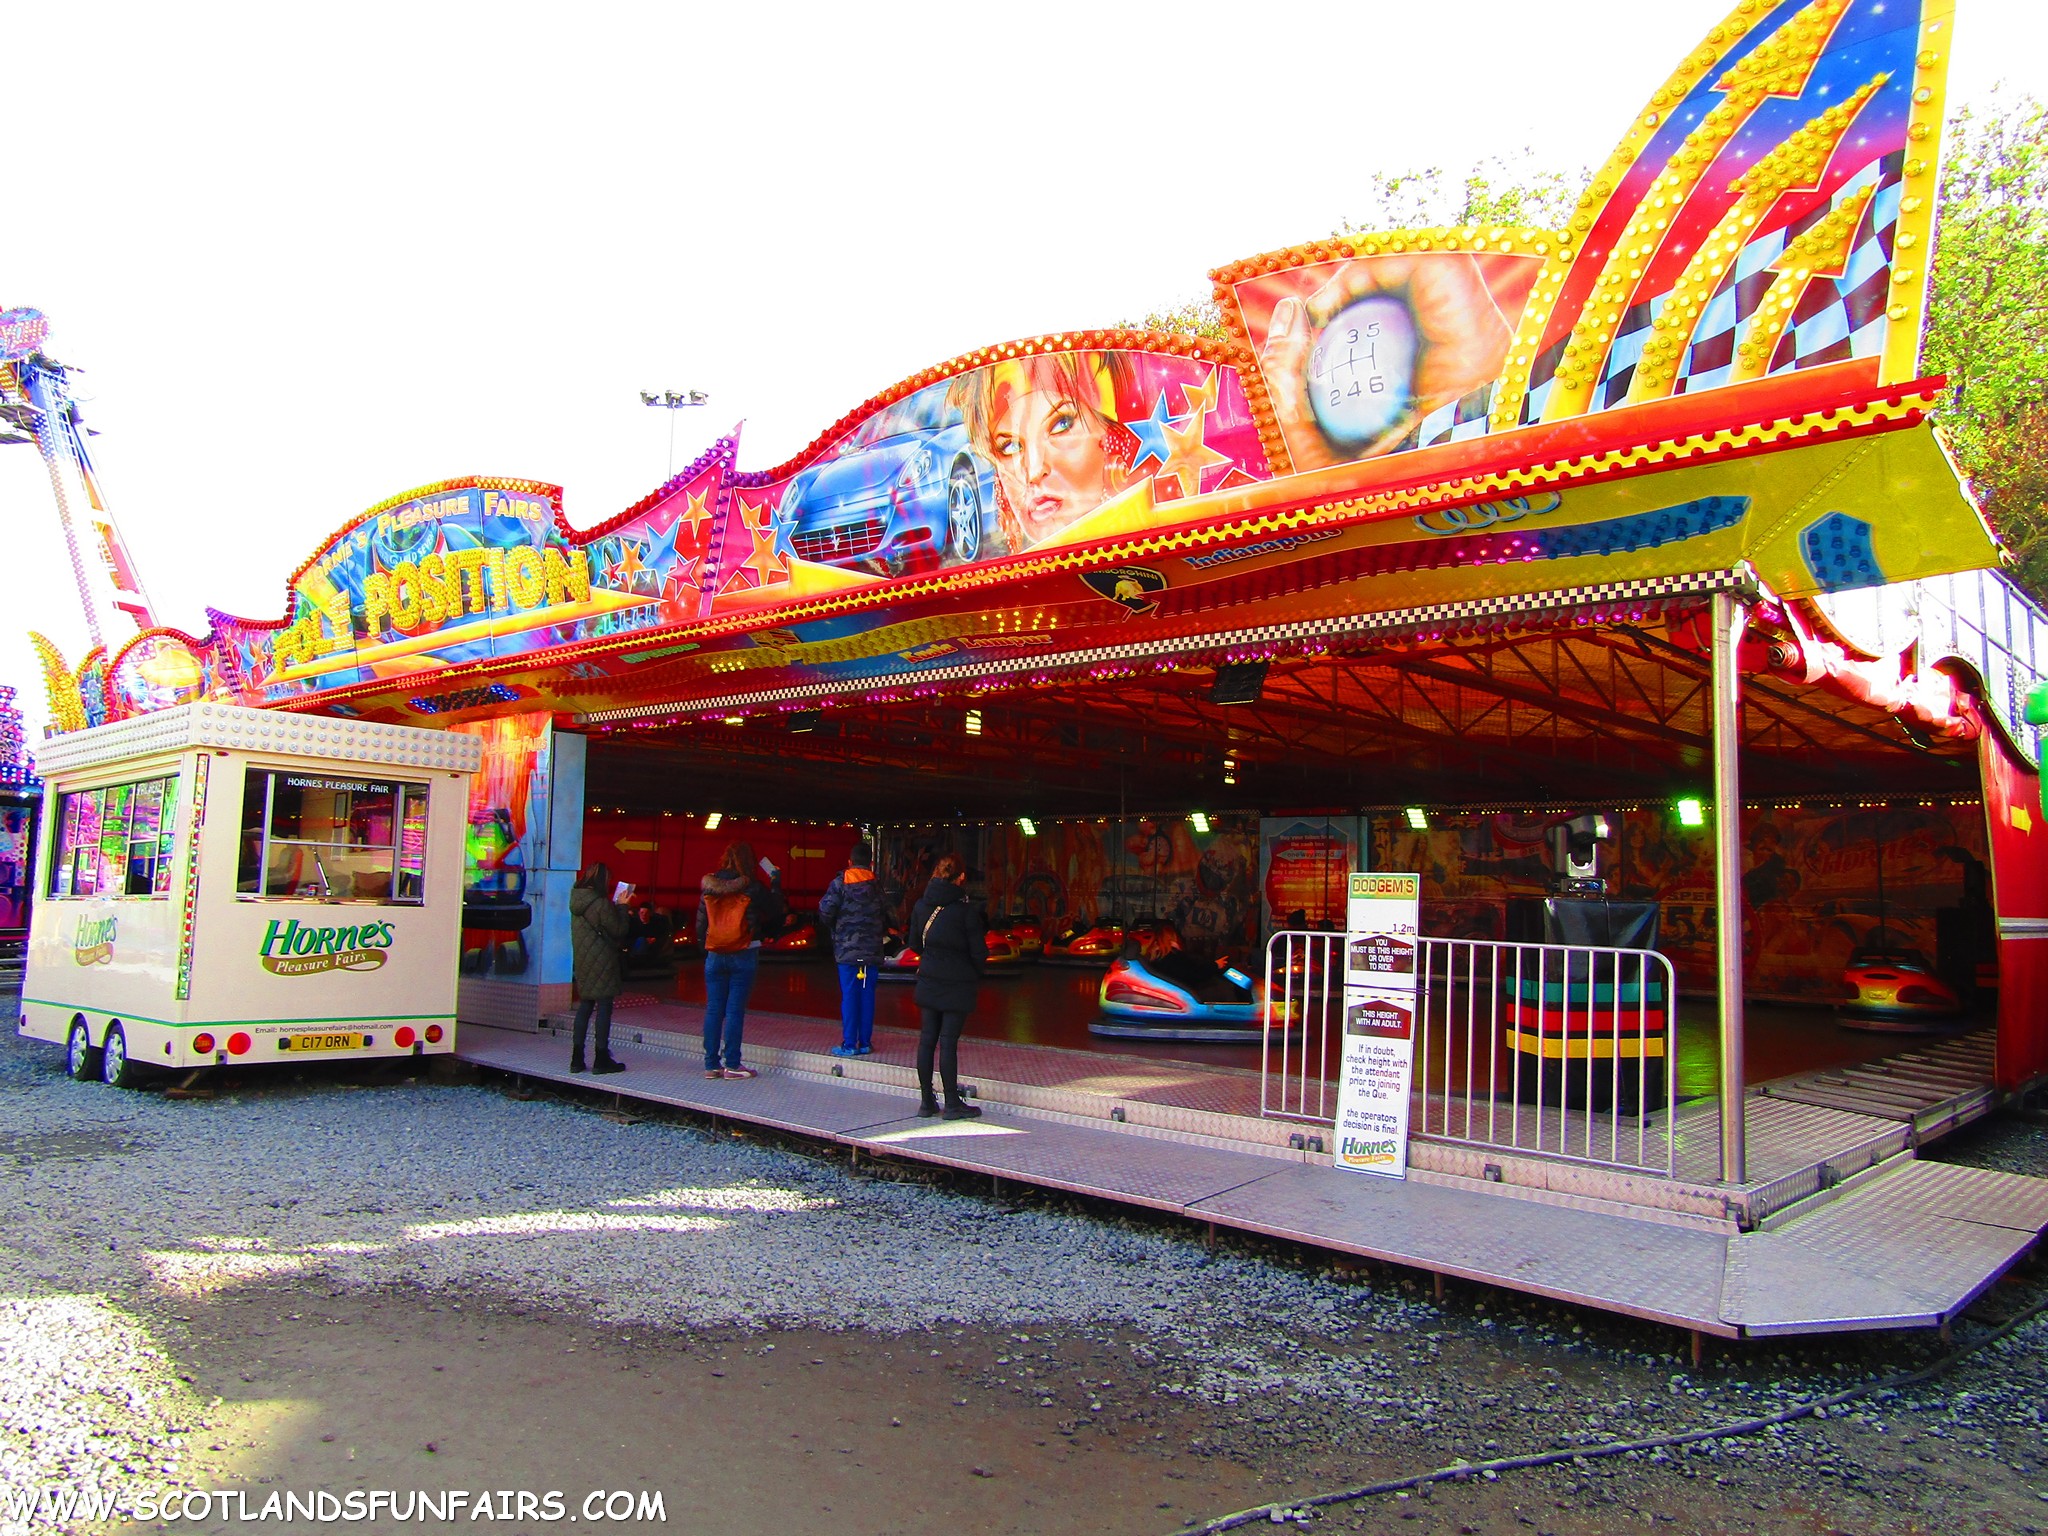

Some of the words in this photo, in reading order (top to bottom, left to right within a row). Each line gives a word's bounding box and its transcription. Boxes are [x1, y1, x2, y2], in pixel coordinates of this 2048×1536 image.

[1346, 328, 1359, 344] 3
[1366, 322, 1381, 338] 5
[1329, 388, 1342, 408] 2
[1346, 380, 1362, 397] 4
[1368, 375, 1384, 394] 6
[376, 495, 470, 537] PLEASURE
[483, 491, 543, 522] FAIRS
[273, 588, 355, 677] POLE
[362, 545, 592, 640] POSITION
[287, 777, 323, 789] HORNES
[325, 781, 368, 792] PLEASURE
[370, 784, 389, 794] FAIR
[1352, 878, 1414, 893] DODGEM'S
[1392, 923, 1415, 933] 1.2m
[1374, 938, 1388, 946] YOU
[1350, 945, 1367, 954] MUST
[1367, 946, 1377, 954] BE
[1376, 946, 1391, 955] THIS
[1391, 947, 1414, 956] HEIGHT
[275, 959, 329, 973] Pleasure
[334, 951, 367, 966] Fairs
[1368, 954, 1377, 962] OR
[1377, 955, 1394, 963] OVER
[1368, 962, 1377, 970] TO
[1361, 1009, 1376, 1018] THIS
[1376, 1010, 1399, 1020] HEIGHT
[1355, 1017, 1371, 1026] WITH
[1371, 1018, 1380, 1027] AN
[1381, 1019, 1402, 1029] ADULT.
[302, 1036, 322, 1048] C17
[325, 1035, 350, 1048] ORN
[1358, 1043, 1364, 1053] If
[1364, 1045, 1372, 1053] in
[1372, 1045, 1396, 1058] doubt,
[1345, 1053, 1367, 1064] check
[1367, 1056, 1391, 1069] height
[1392, 1058, 1408, 1069] with
[1351, 1065, 1364, 1075] the
[1364, 1067, 1401, 1079] attendant
[1349, 1077, 1367, 1087] prior
[1368, 1078, 1377, 1087] to
[1377, 1079, 1401, 1093] joining
[1358, 1088, 1371, 1098] the
[1371, 1088, 1389, 1100] Que.
[1346, 1108, 1359, 1118] the
[1360, 1110, 1398, 1124] operators
[1342, 1118, 1372, 1131] decision
[1373, 1122, 1380, 1132] is
[1381, 1123, 1399, 1135] final.
